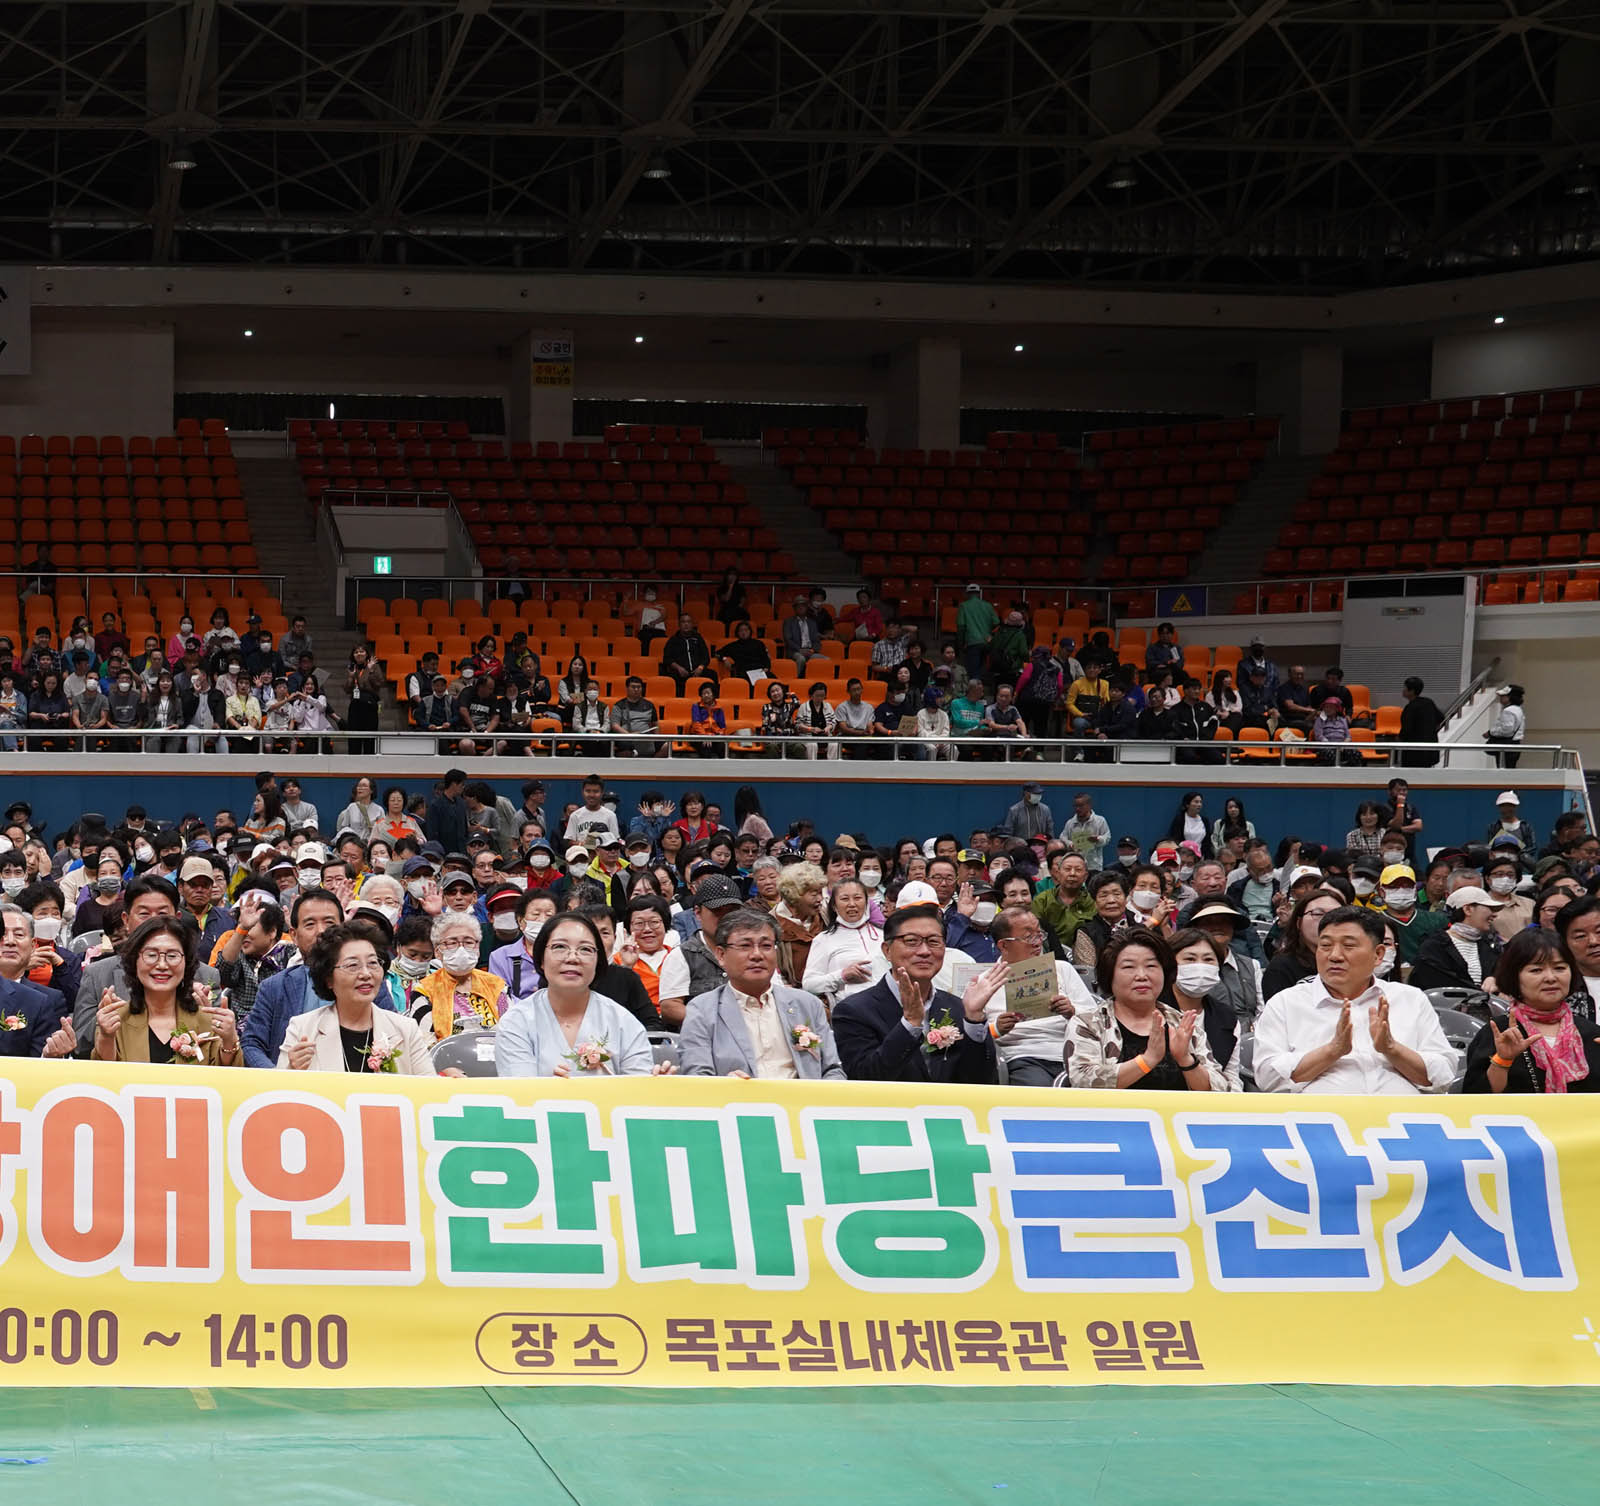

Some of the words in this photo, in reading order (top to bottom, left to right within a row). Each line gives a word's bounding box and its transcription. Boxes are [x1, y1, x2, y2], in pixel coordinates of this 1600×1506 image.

[203, 1313, 349, 1370] 14:00
[664, 1317, 1071, 1373] 목포실내체육관
[1084, 1318, 1205, 1371] 일원
